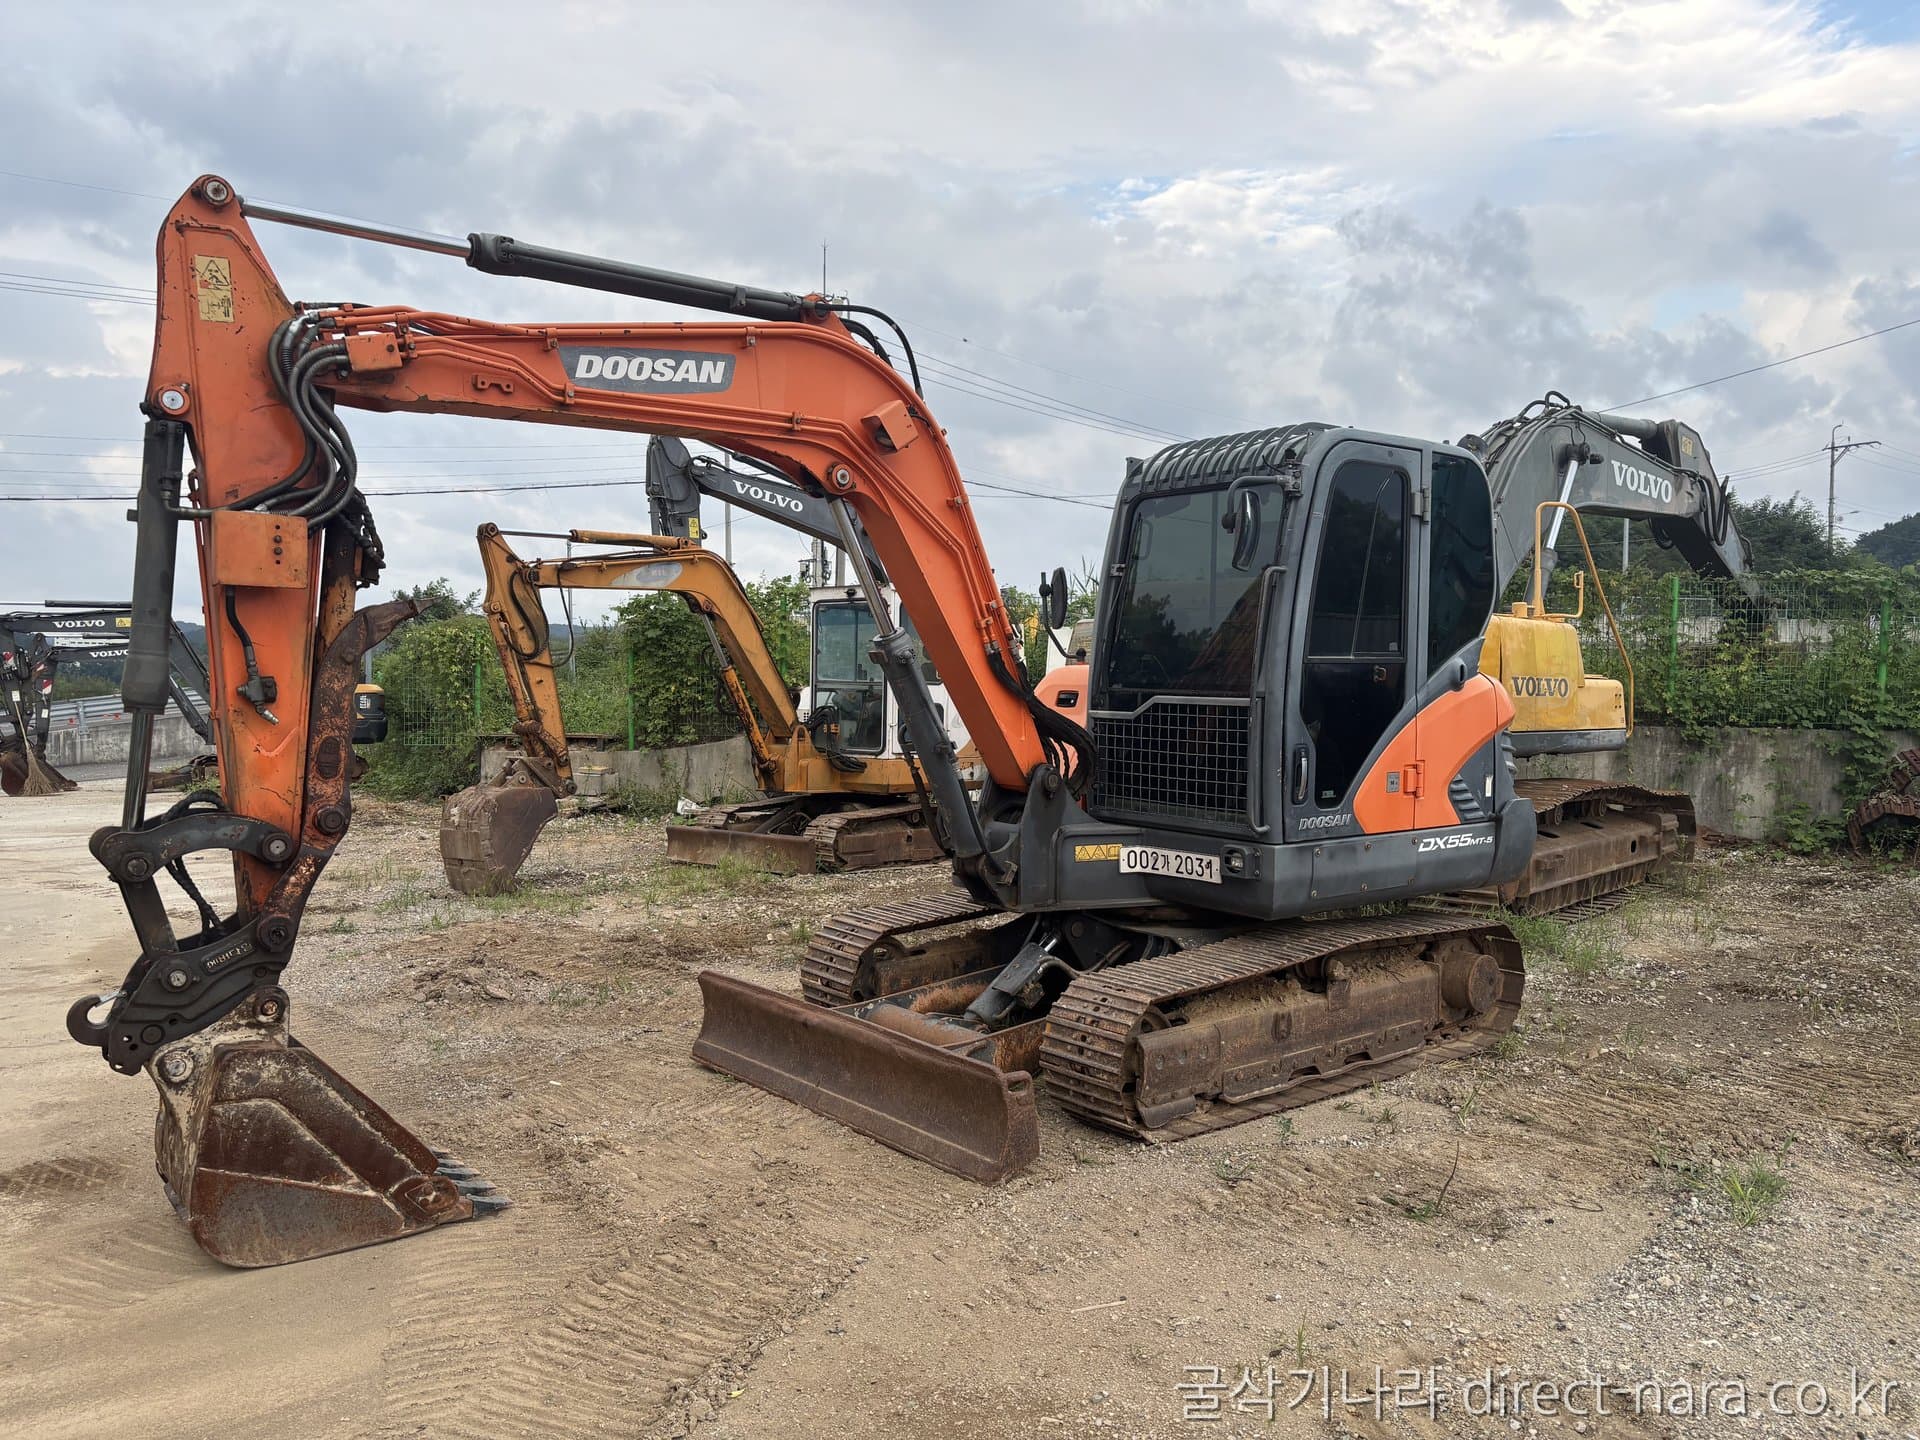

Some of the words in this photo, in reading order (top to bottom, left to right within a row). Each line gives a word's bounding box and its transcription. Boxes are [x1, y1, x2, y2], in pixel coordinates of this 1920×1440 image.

[575, 354, 726, 384] DOOSAN
[1610, 459, 1673, 504] VOLVO
[732, 479, 804, 512] VOLVO
[52, 619, 106, 629] VOLVO
[1511, 676, 1569, 698] VOLVO
[1298, 813, 1352, 831] DOOSAN
